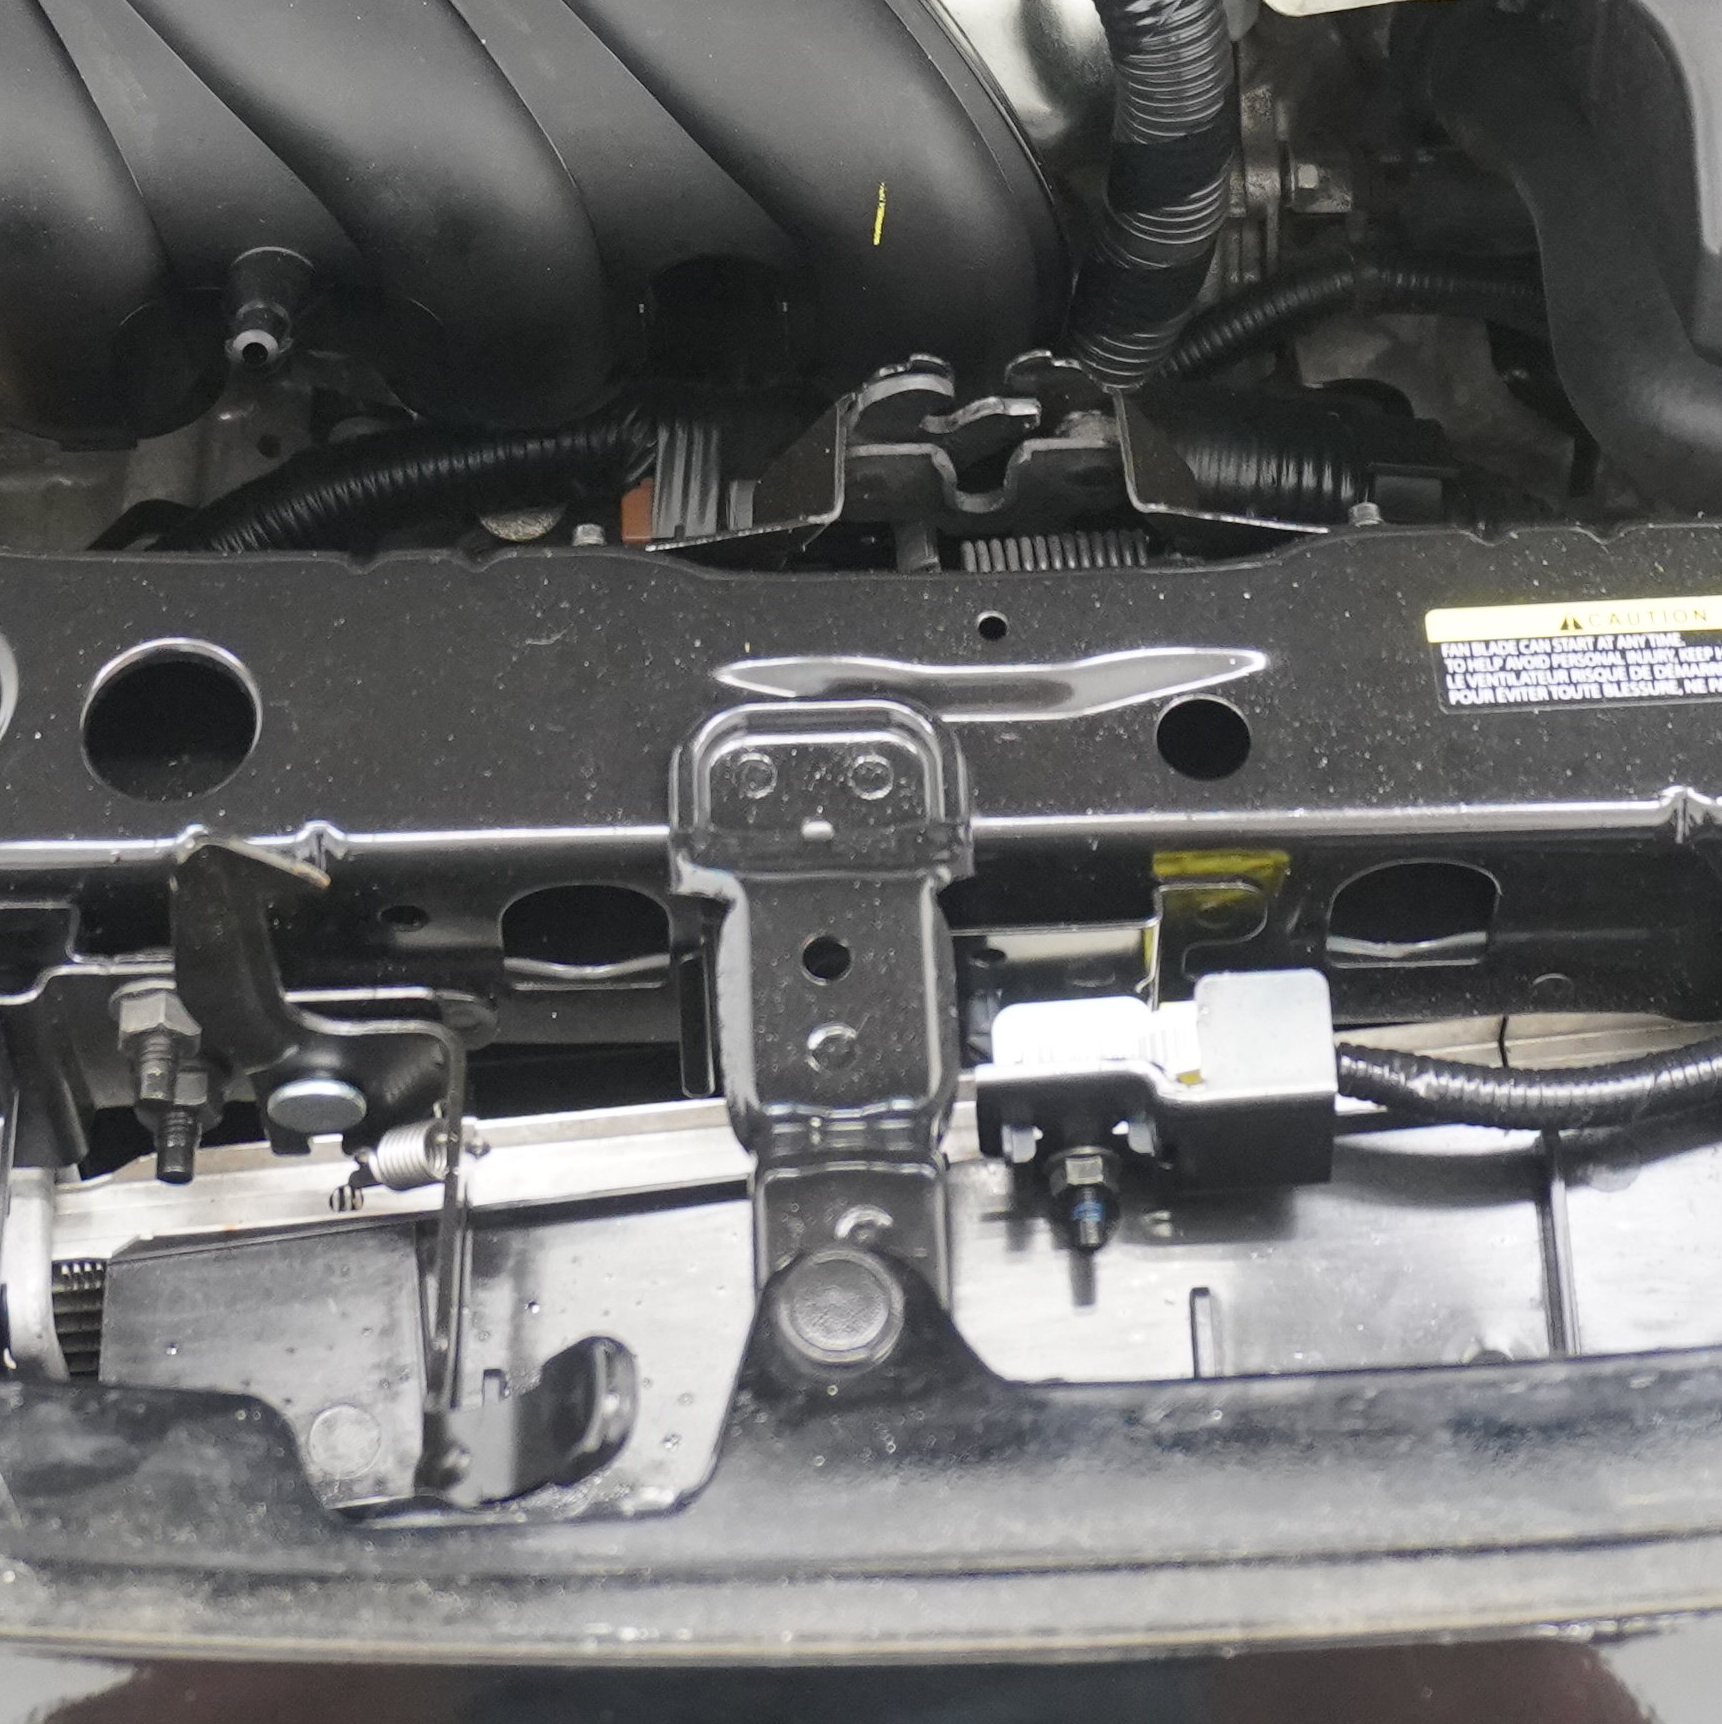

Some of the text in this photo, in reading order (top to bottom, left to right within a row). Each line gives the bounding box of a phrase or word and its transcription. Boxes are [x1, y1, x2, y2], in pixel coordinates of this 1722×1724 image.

[1589, 609, 1707, 626] CAUTION
[1440, 631, 1686, 658] FAN BLADE CAN START AT ANY TIME.
[1444, 658, 1466, 673] TO
[1467, 656, 1505, 672] HELP
[1505, 653, 1550, 670] AVOID
[1552, 651, 1625, 668] PERSONAL
[1679, 646, 1713, 662] KEEP
[1446, 674, 1466, 689] LE
[1466, 669, 1569, 689] VENTILATEUR
[1570, 665, 1627, 683] RISQUE
[1629, 664, 1652, 680] DE
[1448, 688, 1495, 705] POUR
[1549, 682, 1602, 700] TOUTE
[1602, 680, 1684, 698] BLESSURE,
[1684, 678, 1707, 694] NE
